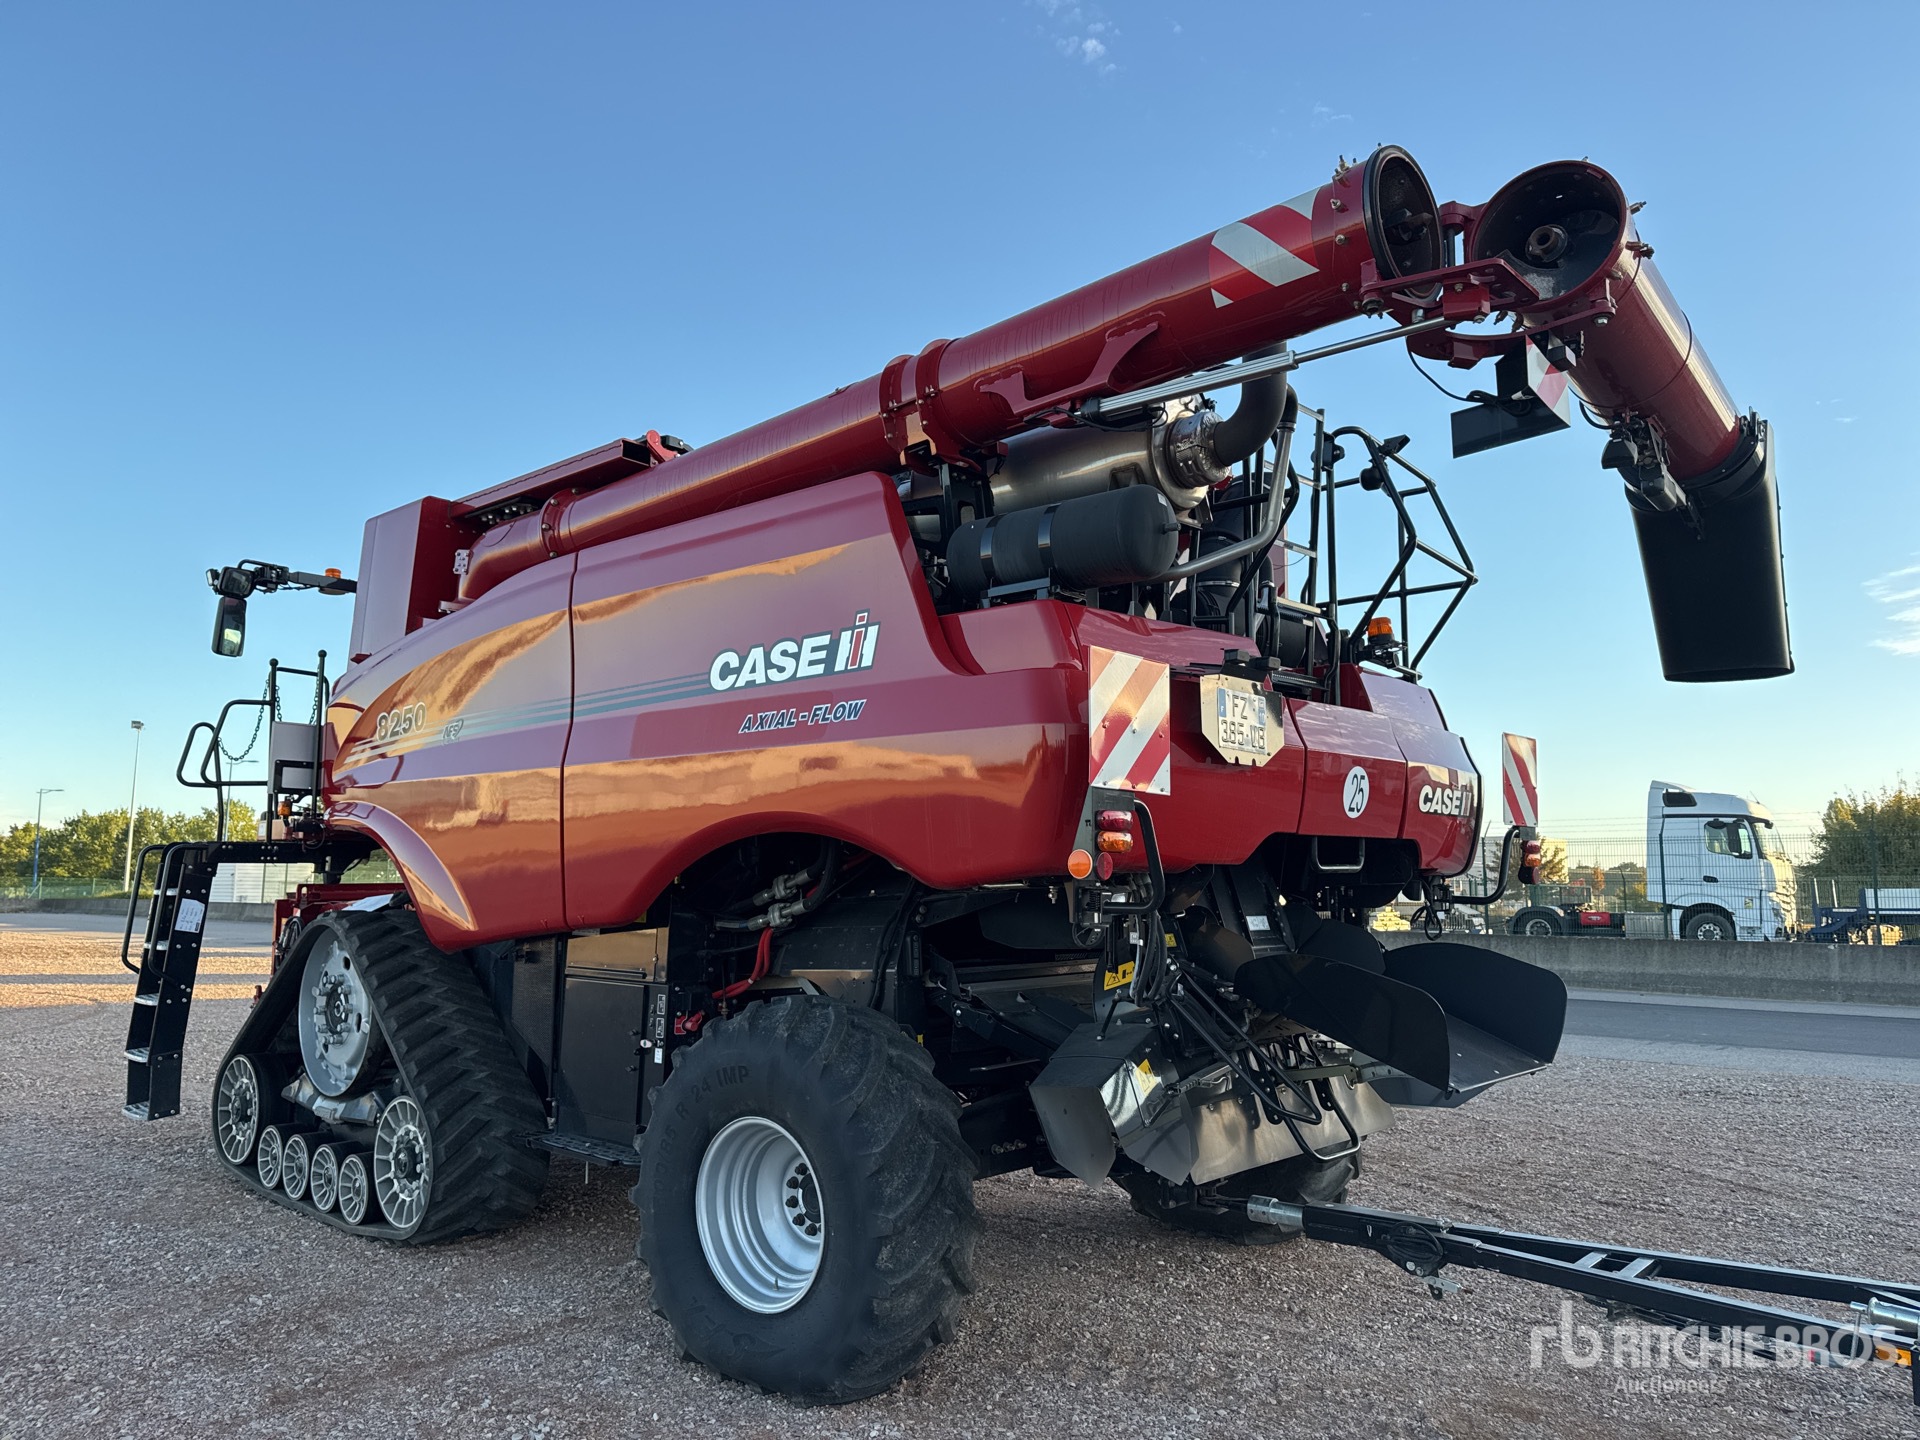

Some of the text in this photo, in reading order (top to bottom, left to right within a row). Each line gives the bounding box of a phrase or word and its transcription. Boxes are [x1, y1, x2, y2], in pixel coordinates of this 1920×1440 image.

[709, 634, 832, 691] CASE
[376, 701, 427, 742] 8250
[1348, 773, 1366, 813] 25
[1418, 784, 1461, 815] CASE
[690, 1076, 713, 1104] 24
[715, 1064, 751, 1088] IMP
